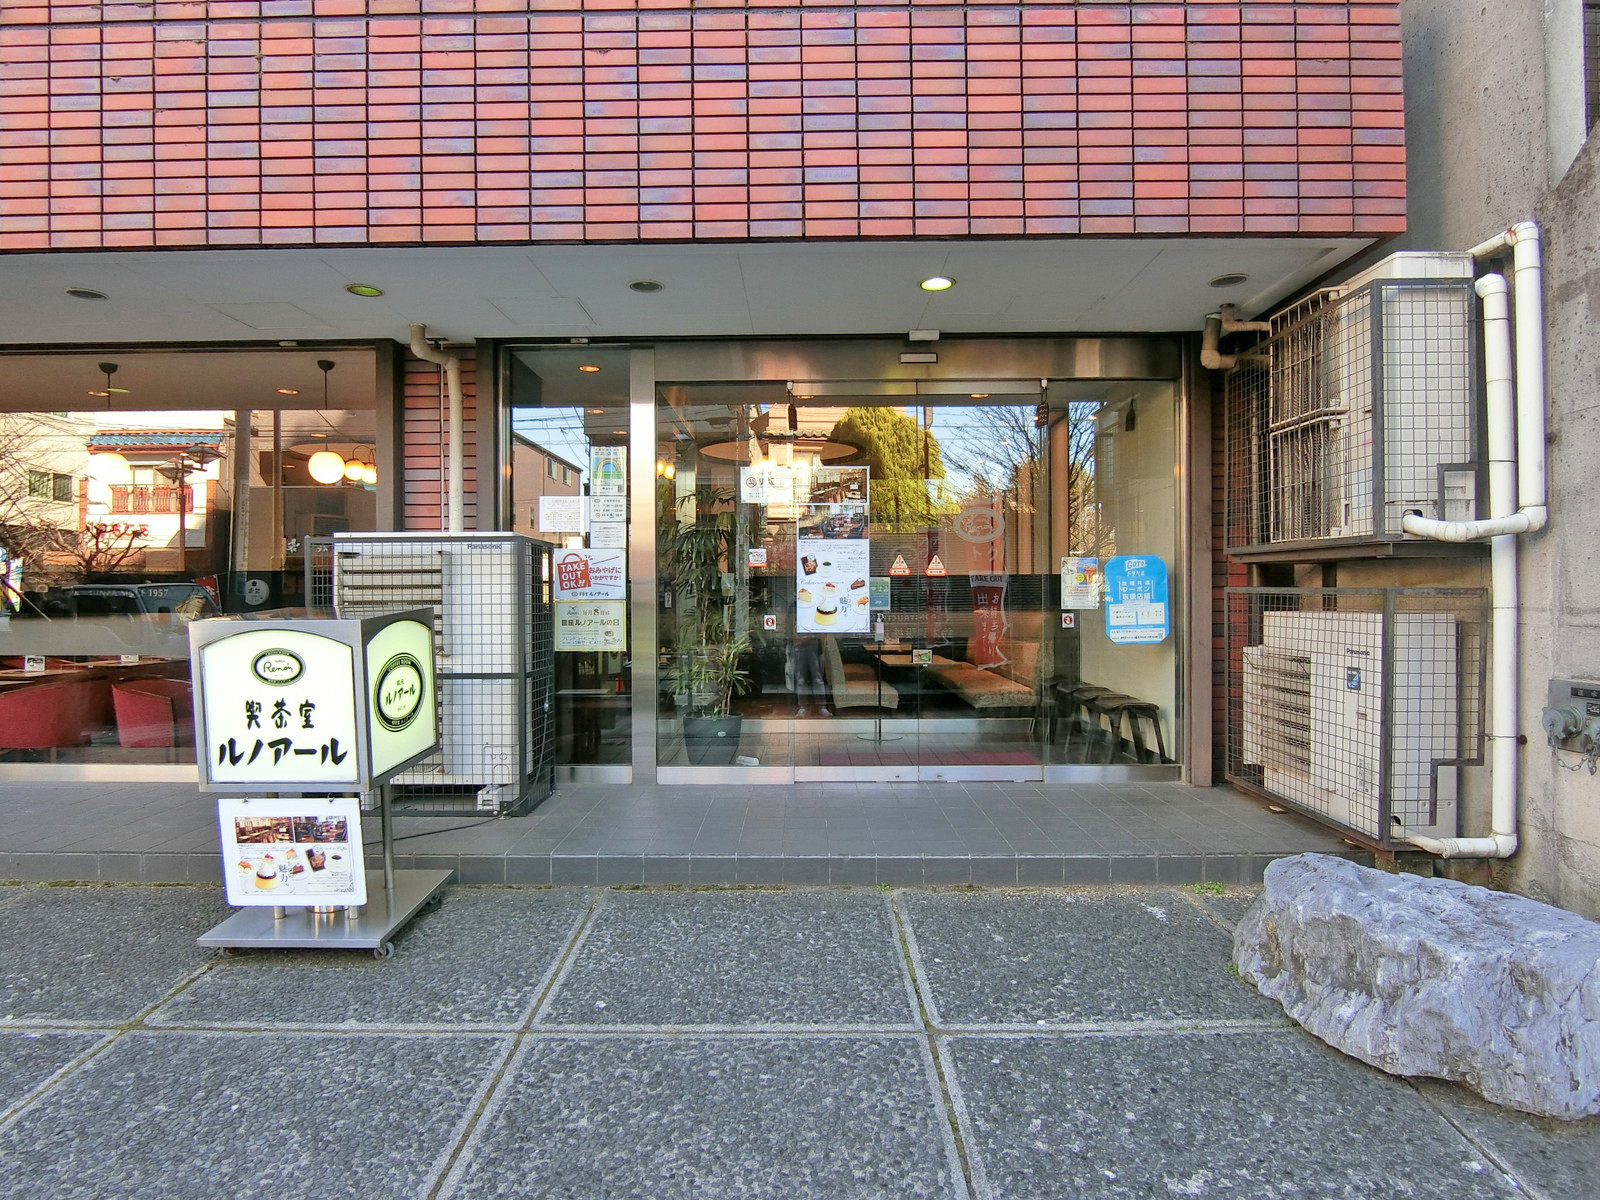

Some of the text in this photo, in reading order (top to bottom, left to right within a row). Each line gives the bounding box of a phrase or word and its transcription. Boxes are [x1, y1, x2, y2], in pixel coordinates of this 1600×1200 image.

[560, 562, 586, 573] TAKE
[562, 571, 582, 581] OUT
[148, 588, 169, 597] 1957
[1346, 648, 1371, 656] Panasonic
[263, 661, 294, 673] Renoir
[385, 683, 417, 706] ルノアール
[245, 698, 317, 730] 喫茶室
[218, 736, 348, 767] ルノアール
